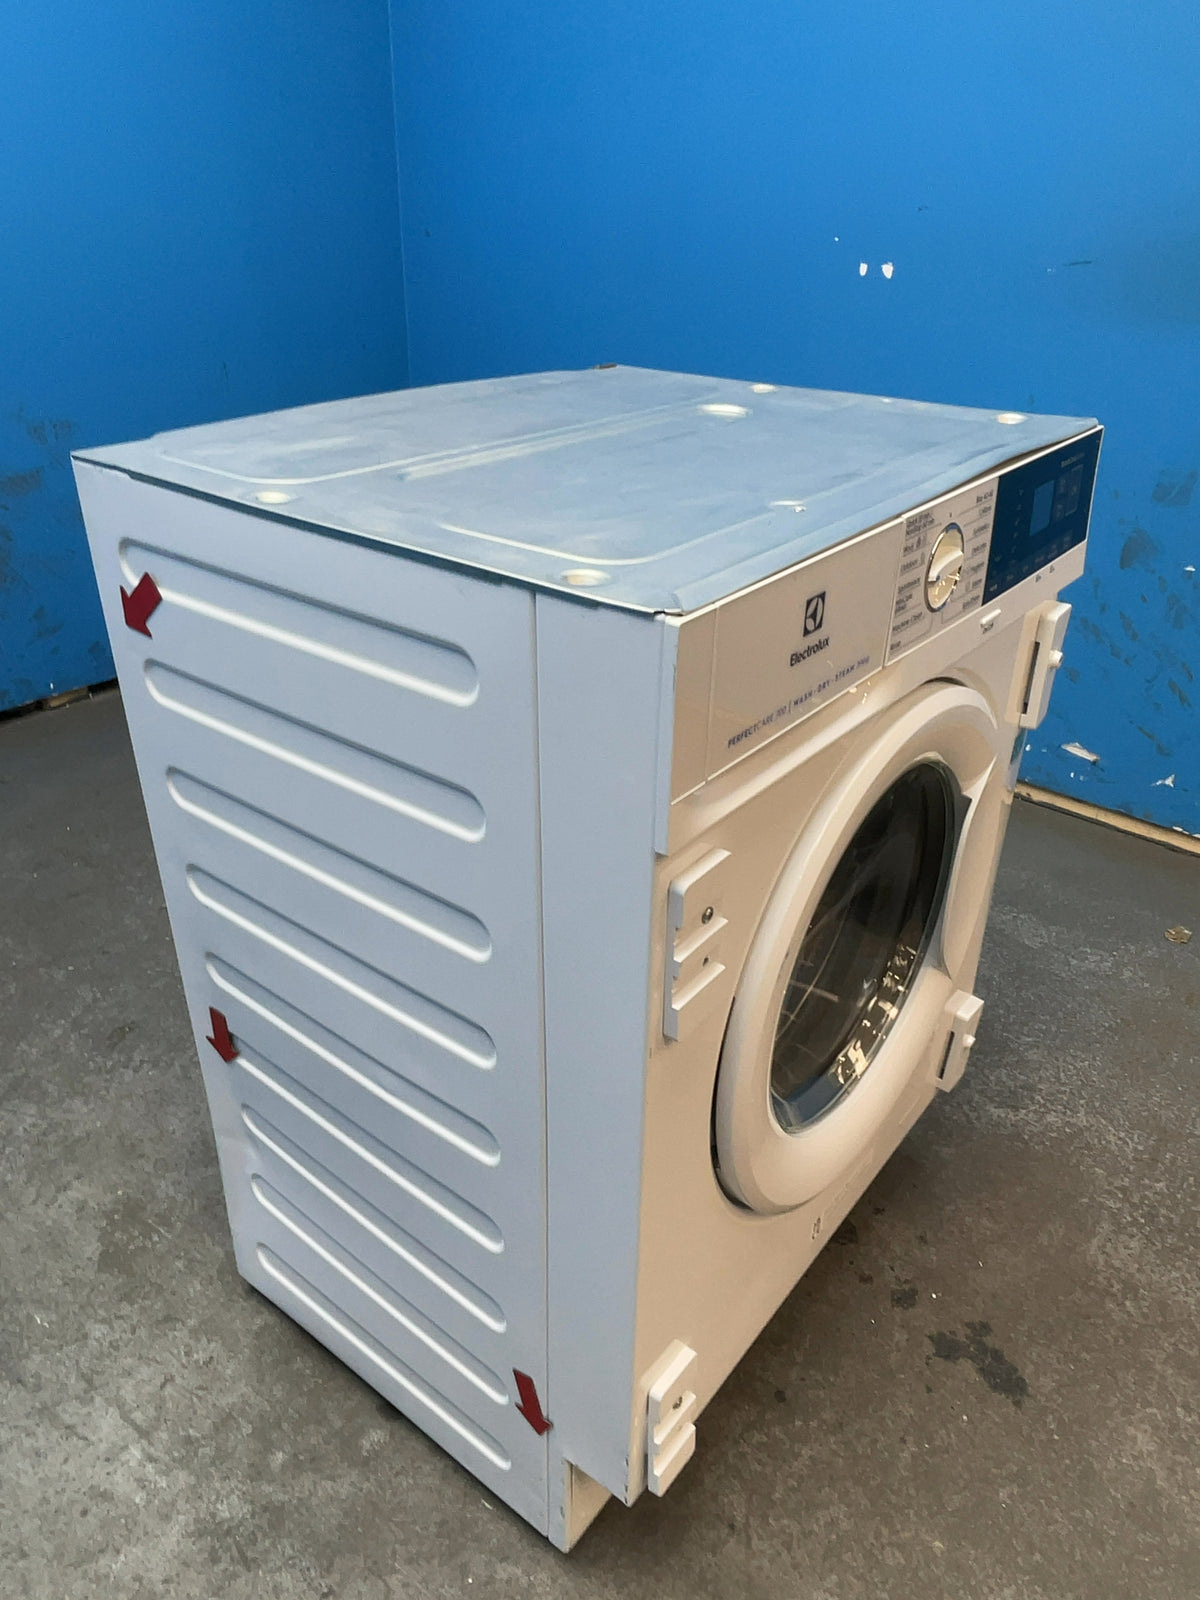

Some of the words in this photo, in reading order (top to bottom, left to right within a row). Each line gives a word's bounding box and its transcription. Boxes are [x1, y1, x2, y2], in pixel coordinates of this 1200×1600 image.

[789, 636, 830, 667] Electrolux
[793, 689, 813, 707] WASH
[817, 681, 831, 693] DRY
[835, 664, 855, 682] STEAM
